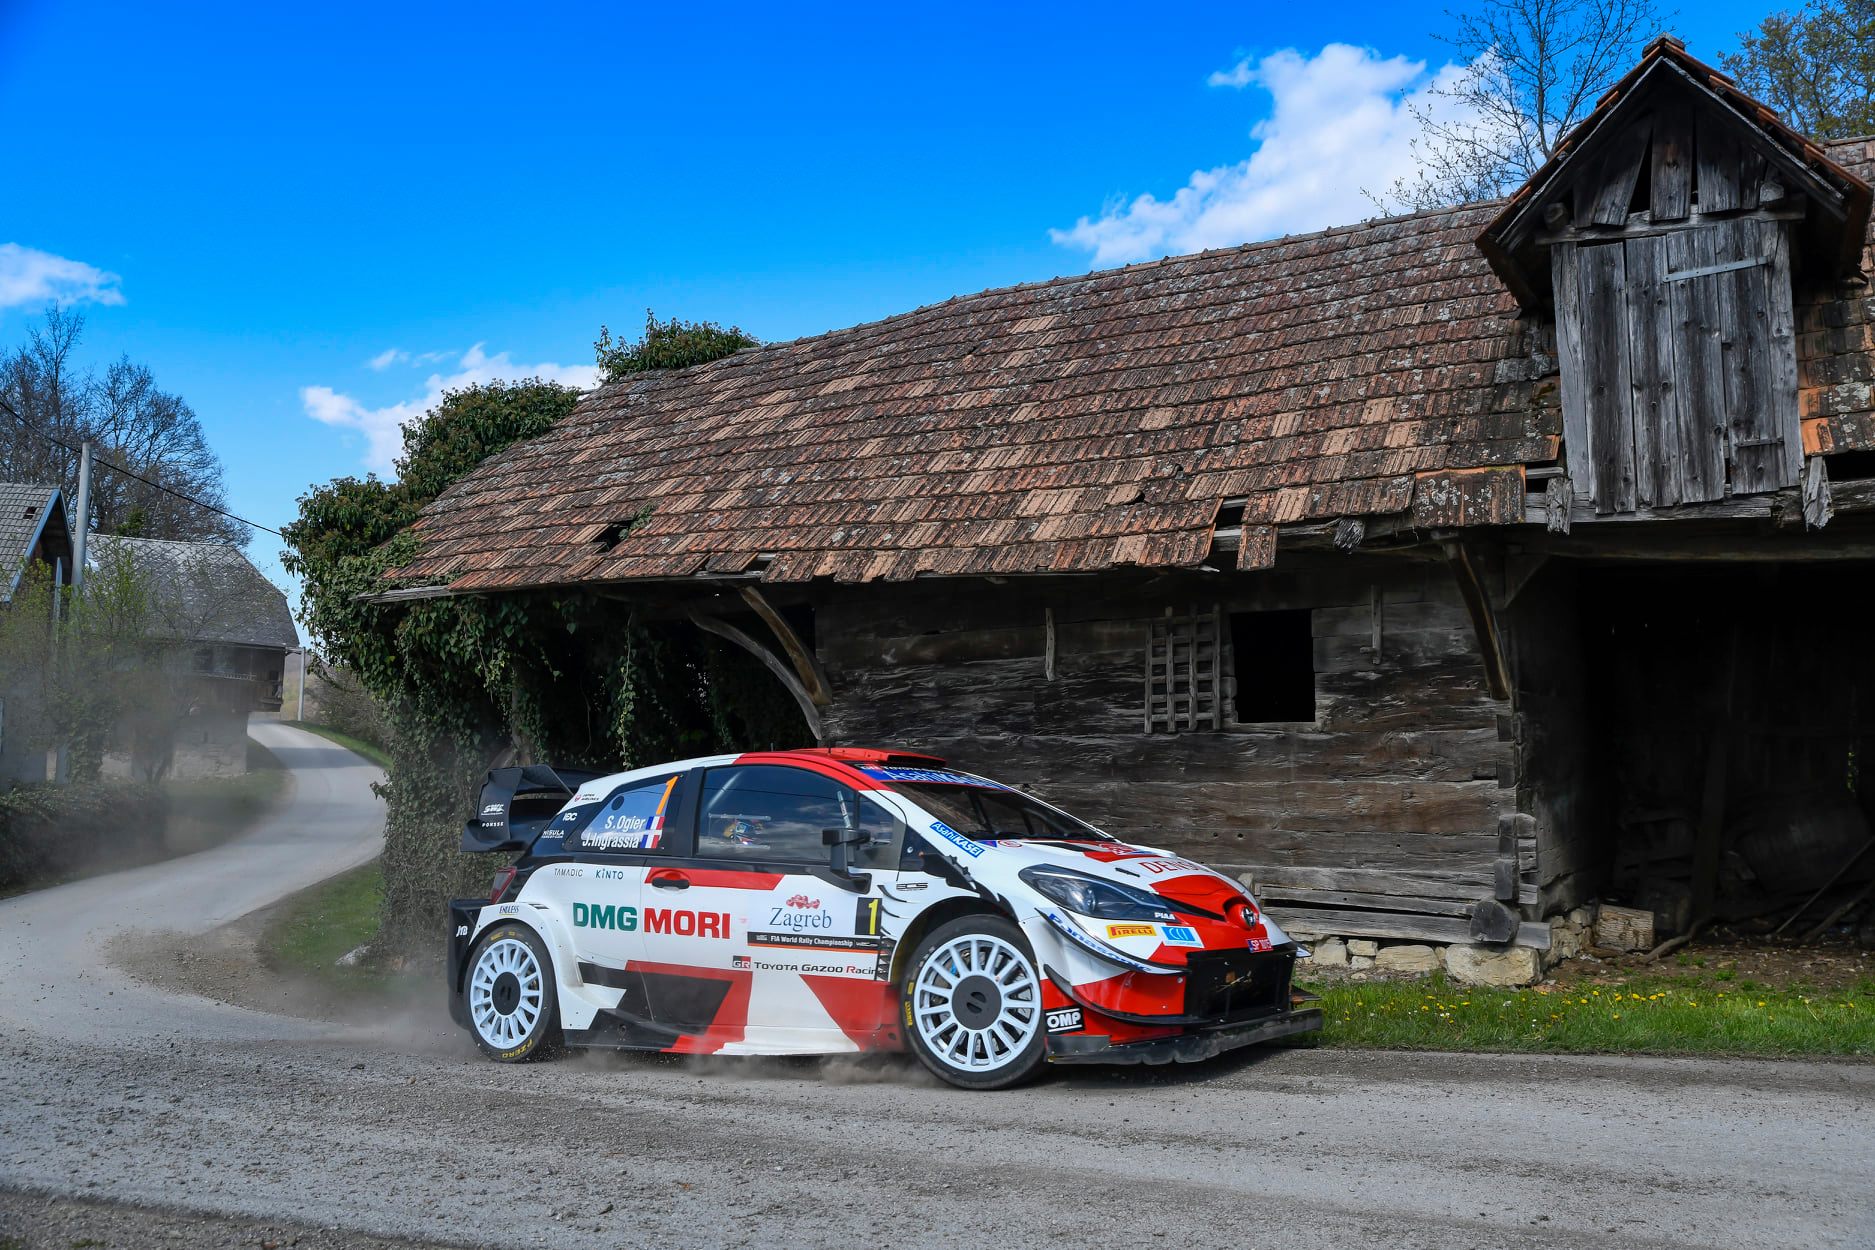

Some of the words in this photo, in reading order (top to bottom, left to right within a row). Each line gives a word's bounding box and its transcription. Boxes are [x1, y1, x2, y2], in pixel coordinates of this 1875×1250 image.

[656, 775, 679, 815] 1
[554, 868, 583, 877] TAMADIC
[573, 902, 638, 931] DMG
[644, 907, 731, 939] MORI
[769, 907, 832, 932] Zagreb
[868, 898, 879, 935] 1
[1154, 911, 1176, 920] PIAA
[1111, 925, 1153, 936] PIRELLI
[798, 937, 813, 945] Rally
[814, 938, 853, 947] Championship
[733, 960, 751, 969] GR
[754, 961, 798, 971] TOYOTA
[802, 964, 843, 973] GAZOO
[1046, 1011, 1081, 1028] OMP
